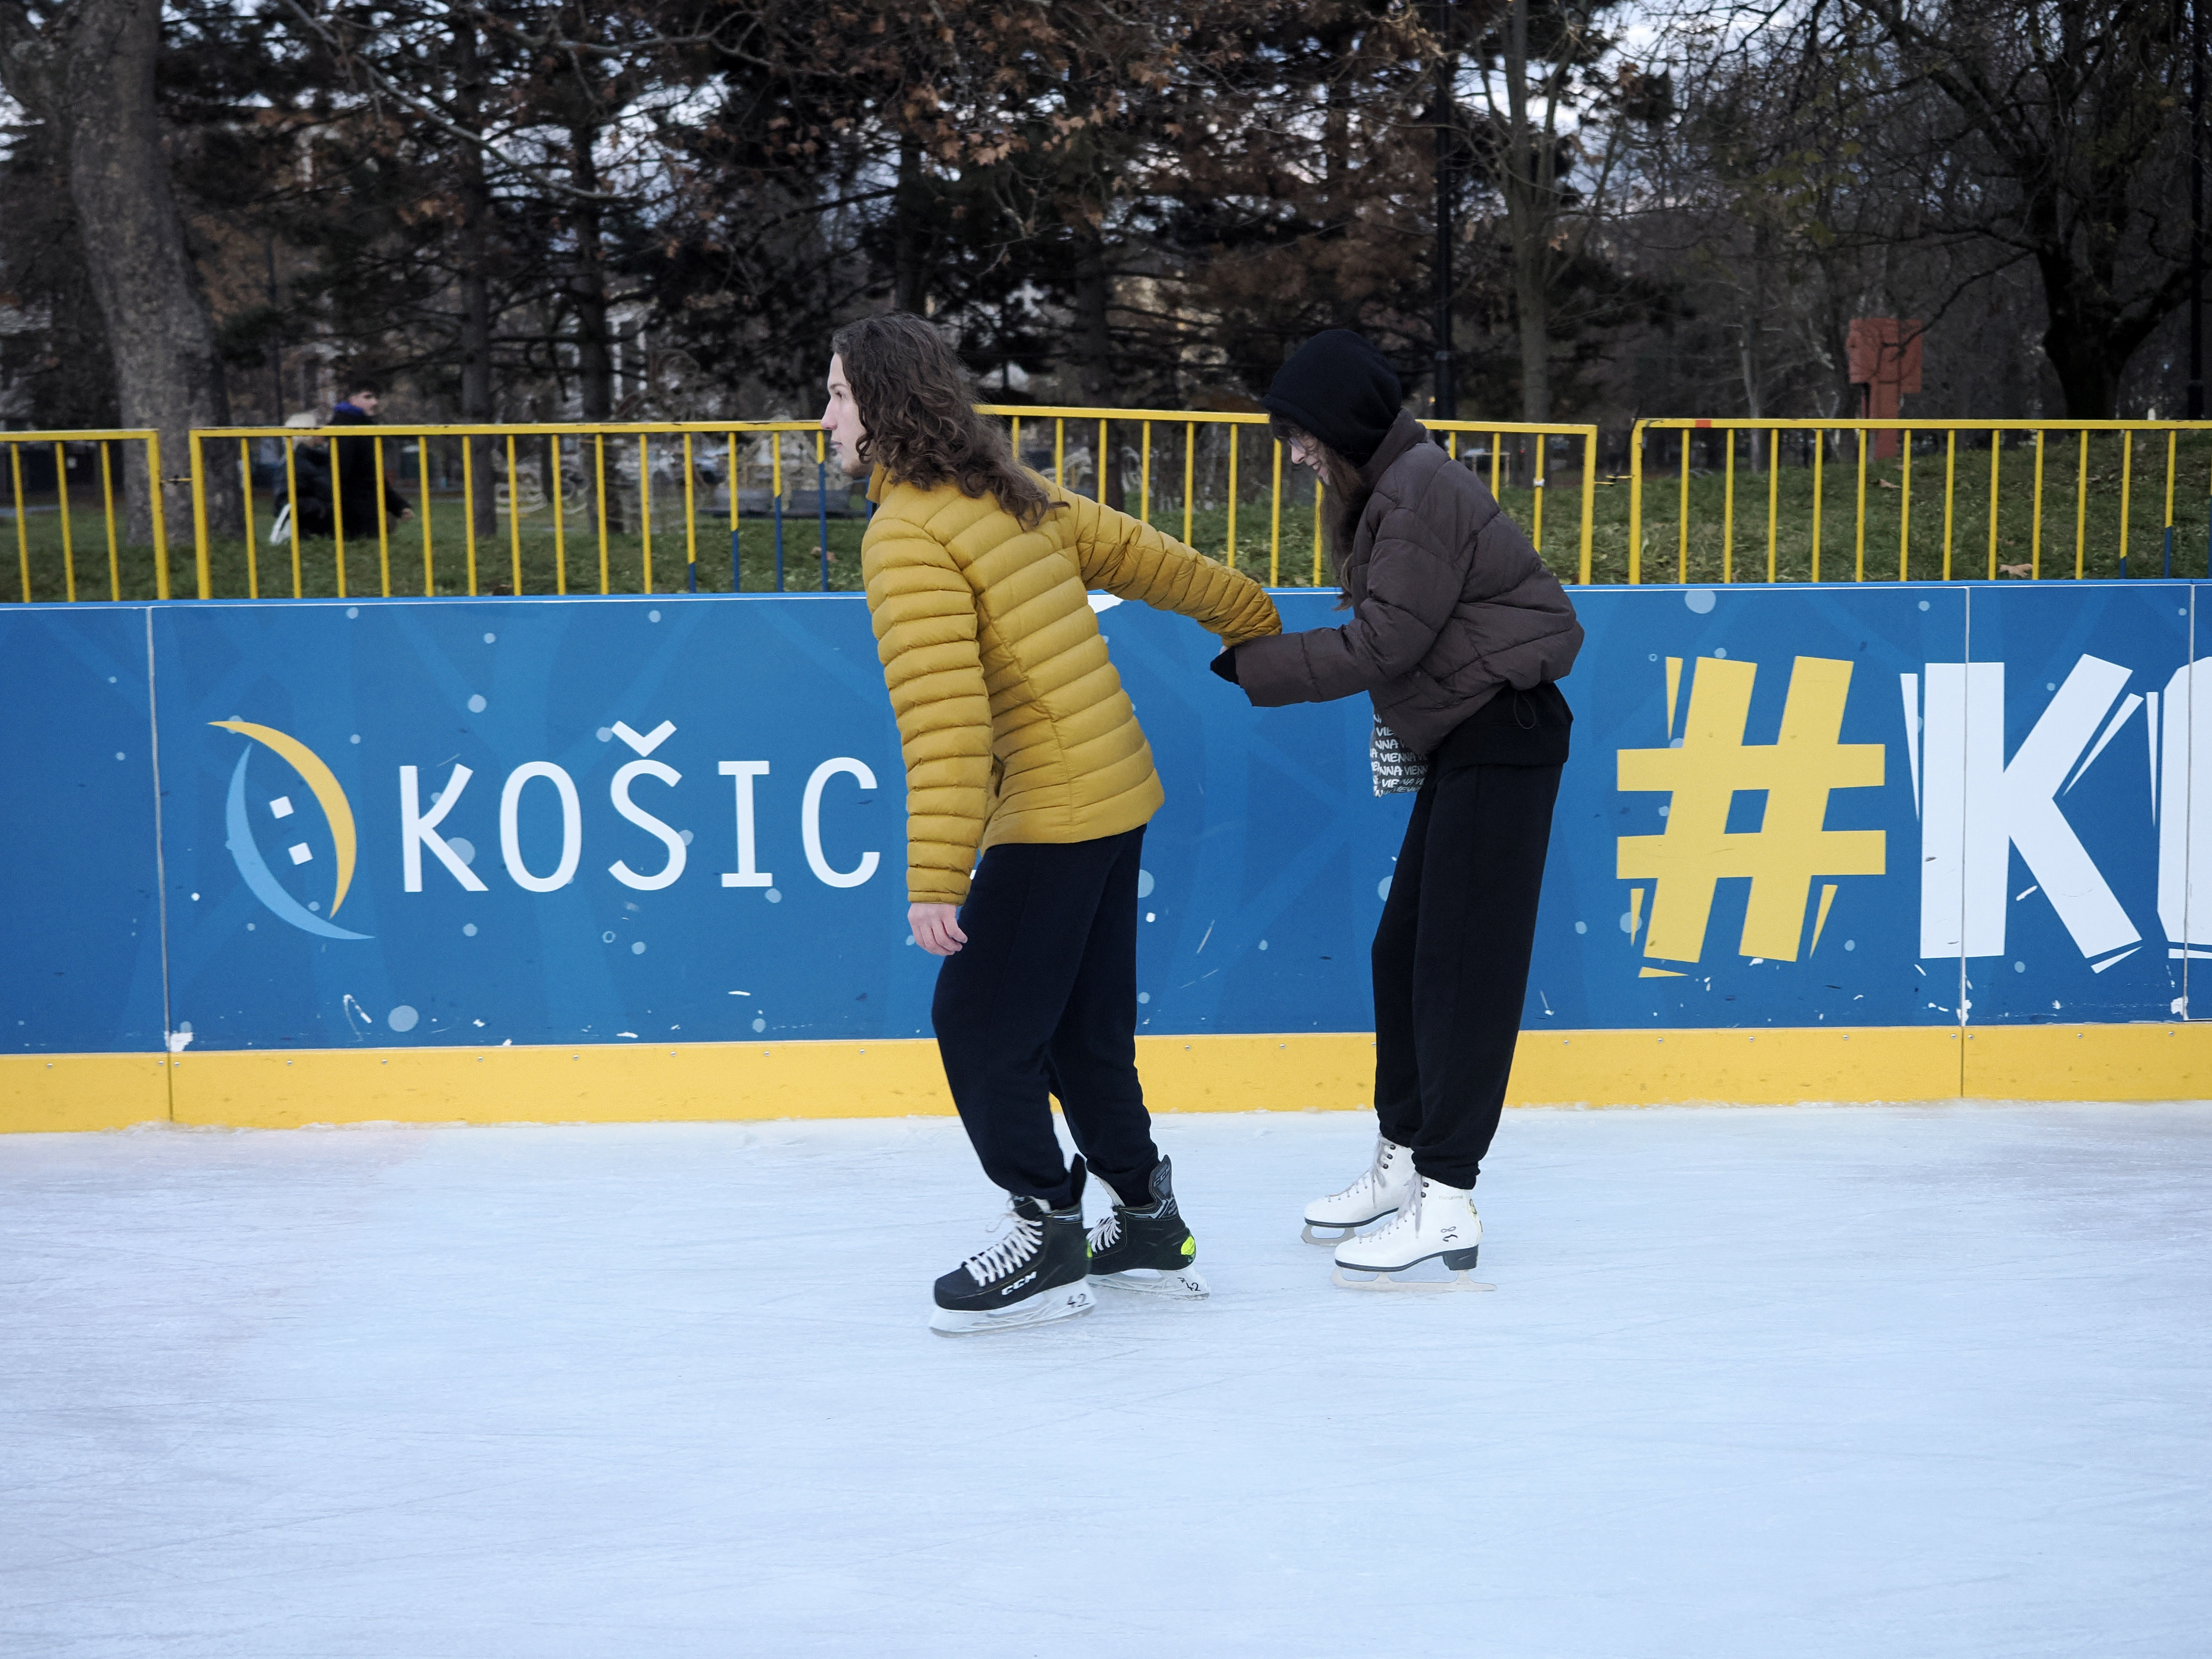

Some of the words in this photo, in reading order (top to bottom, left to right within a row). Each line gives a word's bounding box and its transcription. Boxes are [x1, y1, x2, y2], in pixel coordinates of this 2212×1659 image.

[399, 720, 977, 893] KOŠIC
[1185, 1282, 1202, 1292] 42
[1067, 1293, 1091, 1308] 42
